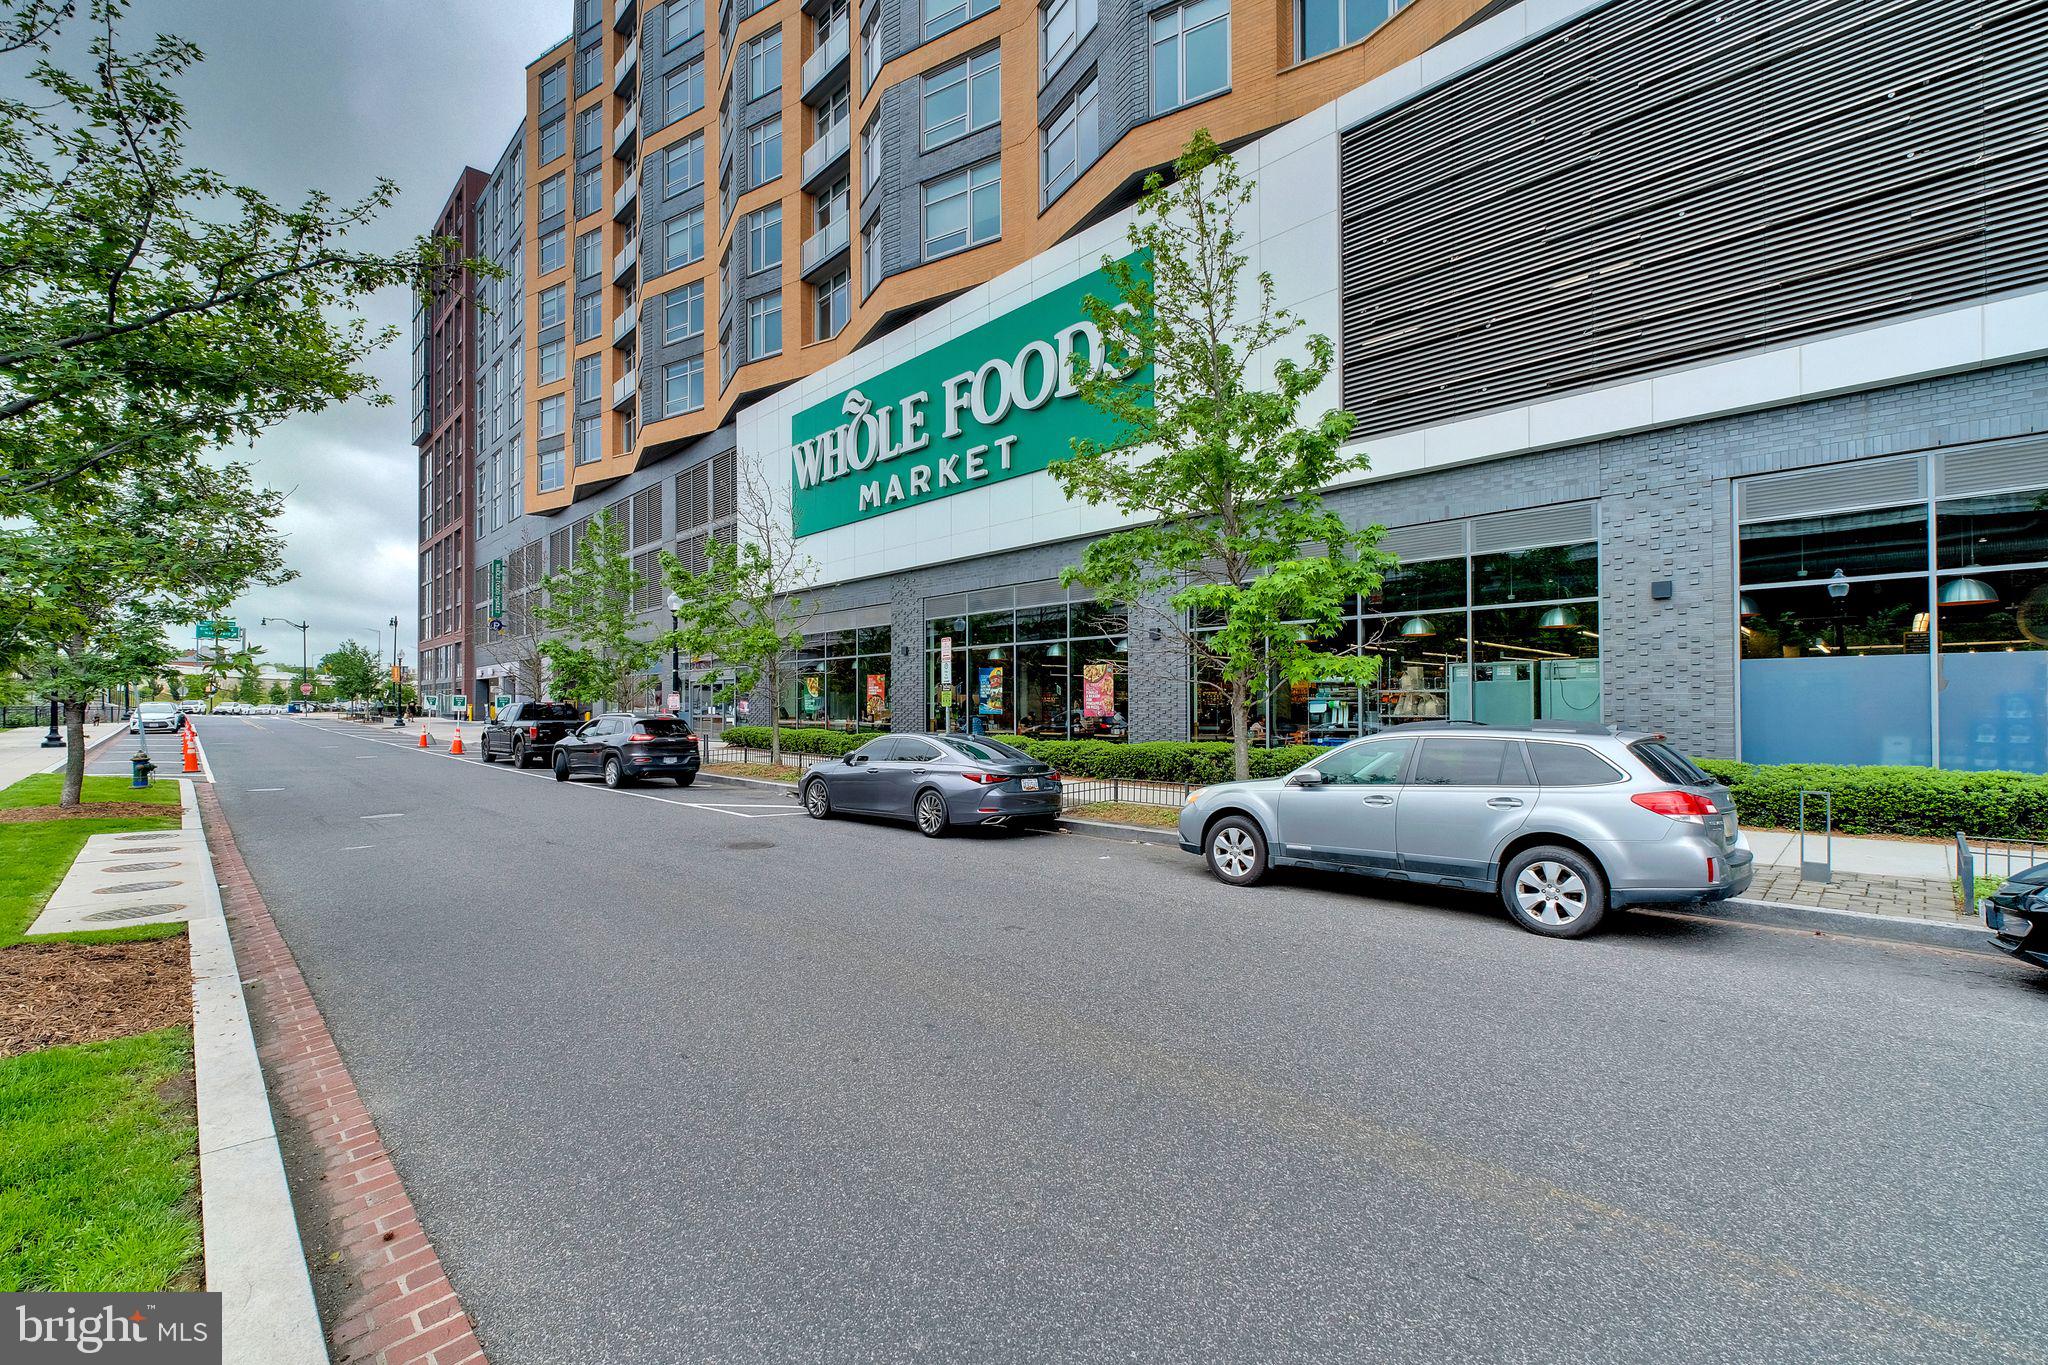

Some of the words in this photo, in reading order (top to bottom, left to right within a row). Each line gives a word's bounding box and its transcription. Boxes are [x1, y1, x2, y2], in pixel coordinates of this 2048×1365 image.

[792, 390, 929, 490] WHOLE
[942, 301, 1144, 439] FOODS
[858, 435, 1018, 511] MARKET
